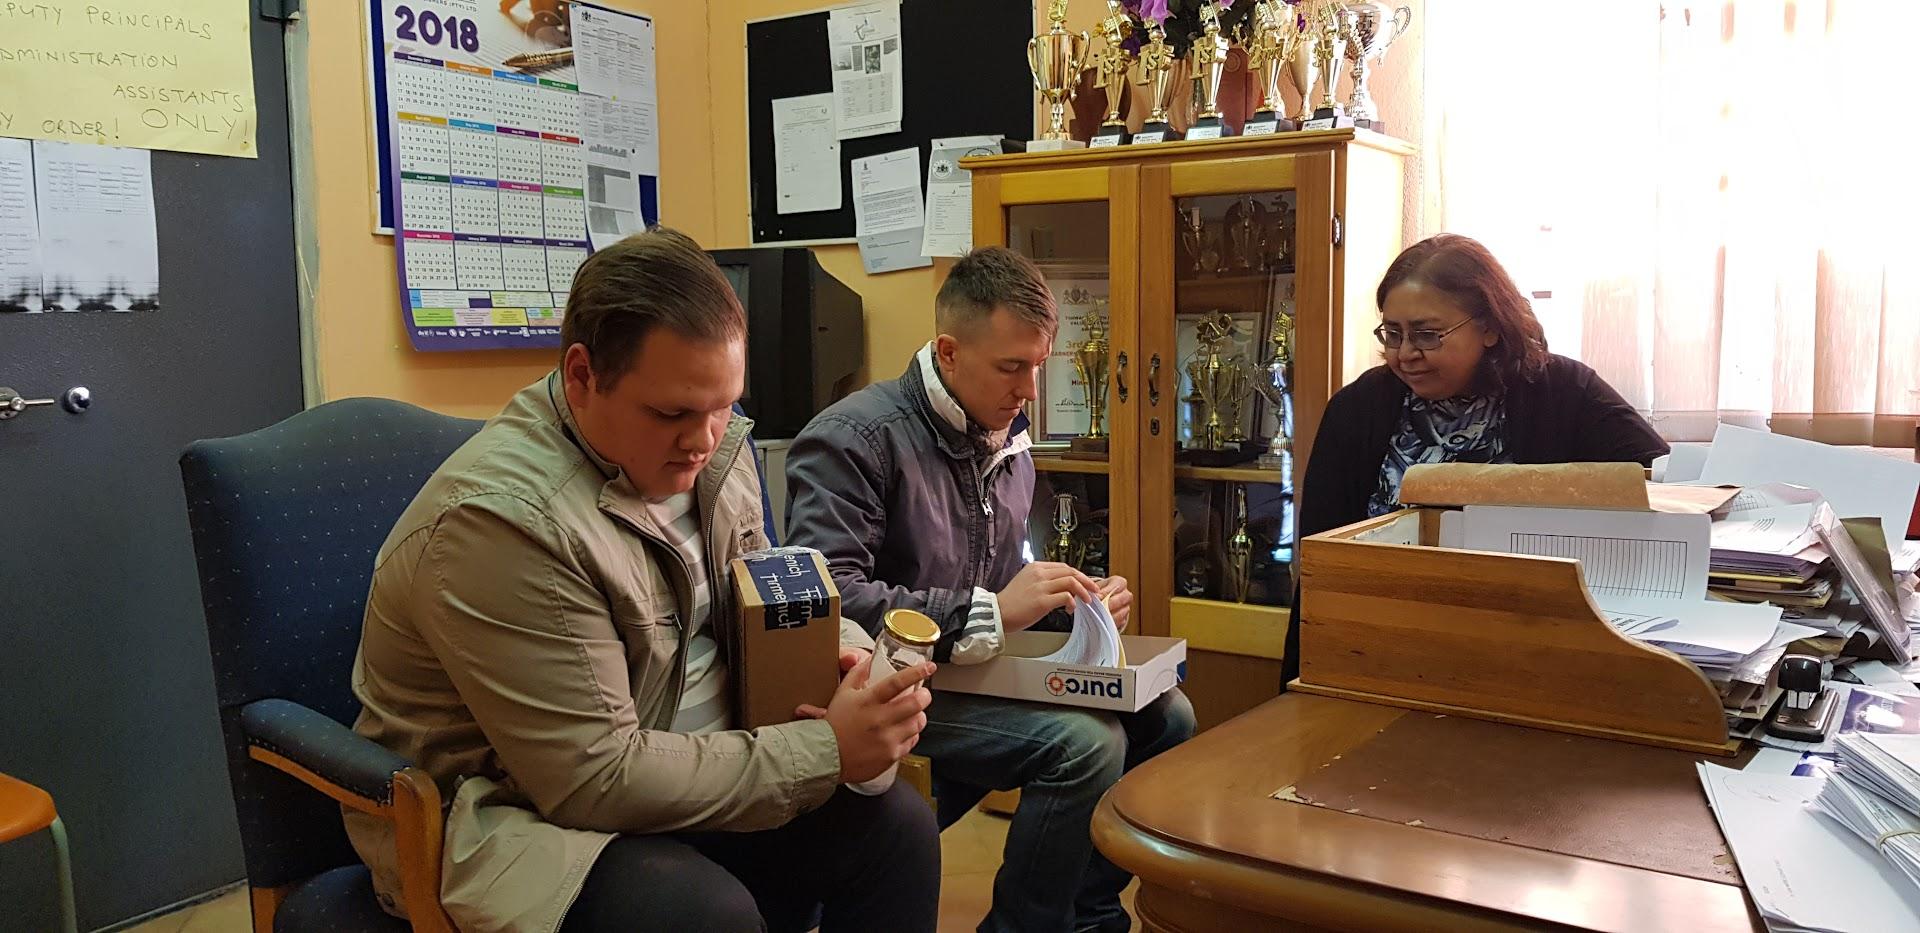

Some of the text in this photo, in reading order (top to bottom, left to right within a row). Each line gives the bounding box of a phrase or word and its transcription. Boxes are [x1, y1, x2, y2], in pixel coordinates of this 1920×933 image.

[0, 2, 61, 25] PUTY
[394, 5, 479, 53] 2018
[113, 85, 243, 113] ASSISTANTS
[0, 112, 14, 129] Y
